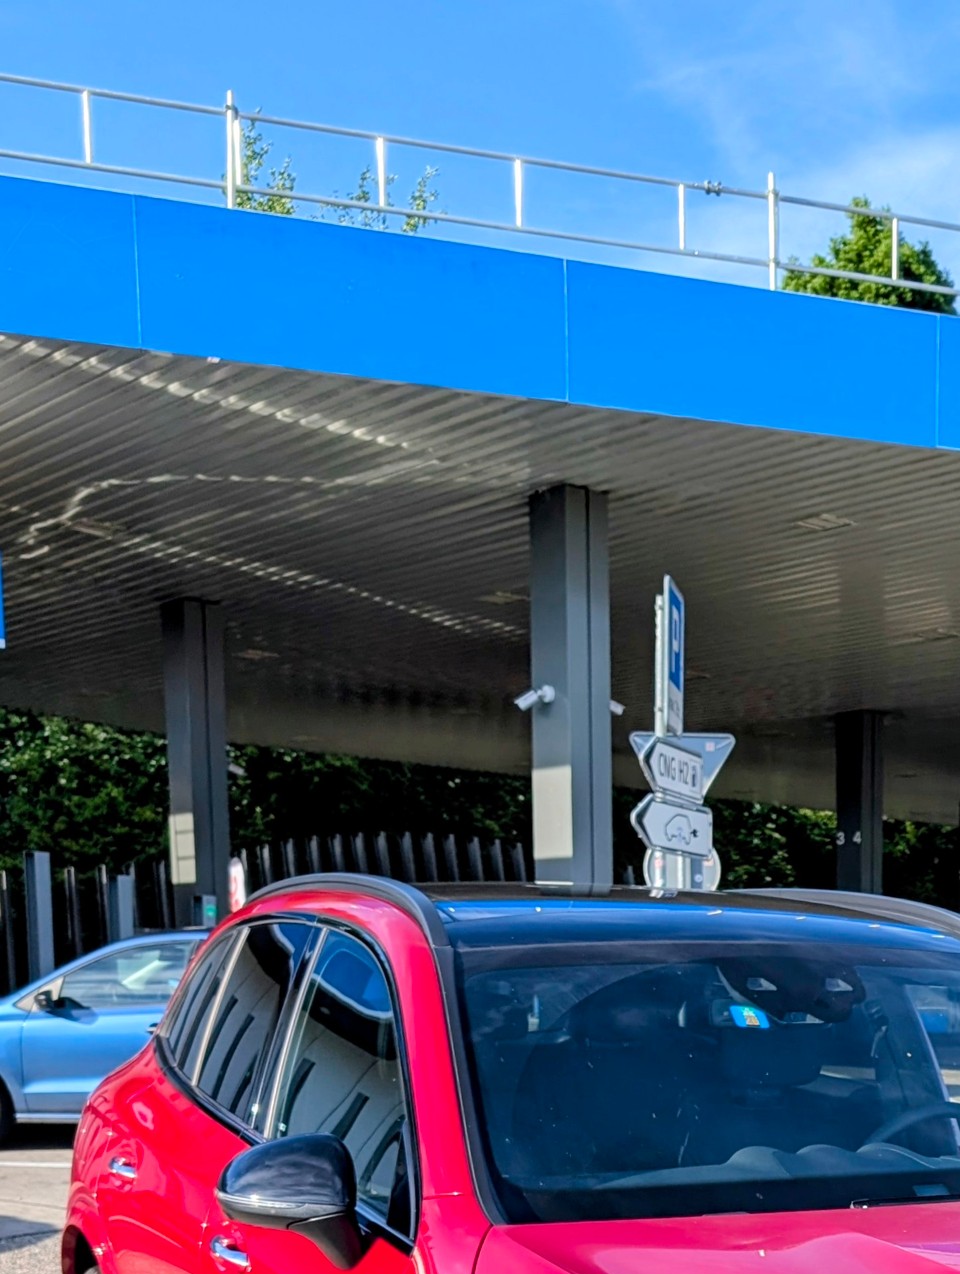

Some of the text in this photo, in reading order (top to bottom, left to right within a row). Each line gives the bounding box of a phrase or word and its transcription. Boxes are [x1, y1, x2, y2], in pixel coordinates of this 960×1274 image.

[671, 605, 680, 673] P
[658, 753, 690, 786] CNG H2
[836, 831, 846, 845] 3
[852, 831, 862, 844] 4
